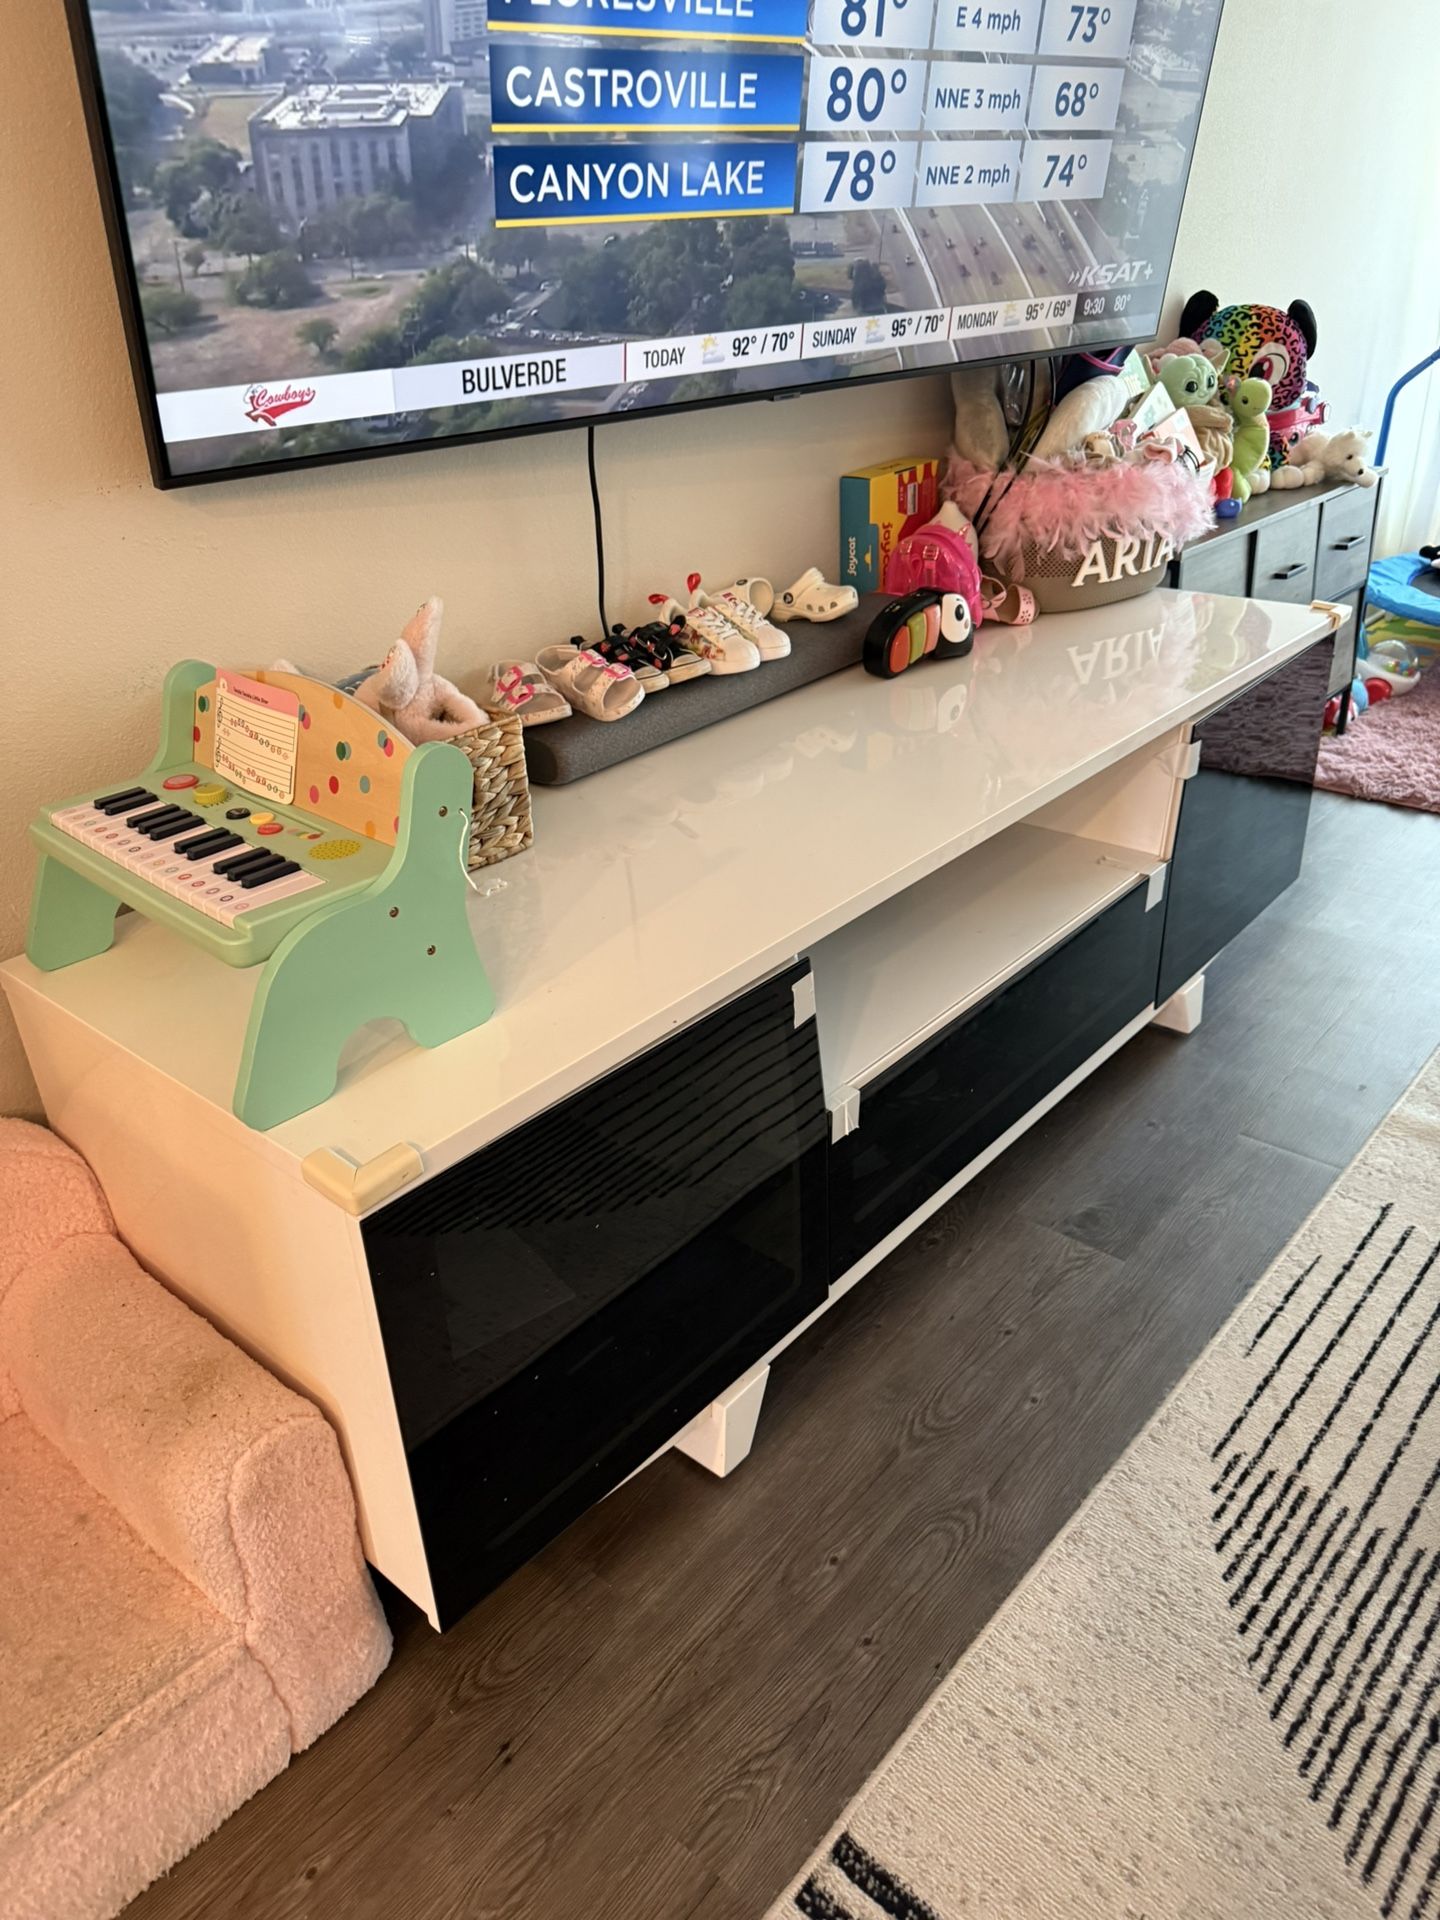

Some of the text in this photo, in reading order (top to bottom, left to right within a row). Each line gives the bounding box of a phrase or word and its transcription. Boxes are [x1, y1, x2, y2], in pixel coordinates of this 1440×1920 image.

[956, 7, 967, 28] E
[971, 8, 983, 28] 4
[988, 9, 1021, 34] mph
[505, 65, 758, 109] CASTROVILLE
[935, 87, 970, 109] NNE
[974, 88, 984, 109] 3
[987, 88, 1021, 114] mph
[509, 160, 765, 203] CANYON LAKE
[926, 166, 960, 186] NNE
[964, 165, 974, 185] 2
[978, 164, 1011, 188] mph
[1083, 297, 1106, 316] 9:30
[956, 310, 998, 331] MONDAY
[812, 326, 858, 349] SUNDAY
[643, 346, 686, 369] TODAY
[461, 358, 567, 395] BULVERDE
[255, 383, 316, 408] Cowboys
[1071, 534, 1176, 588] ARIA
